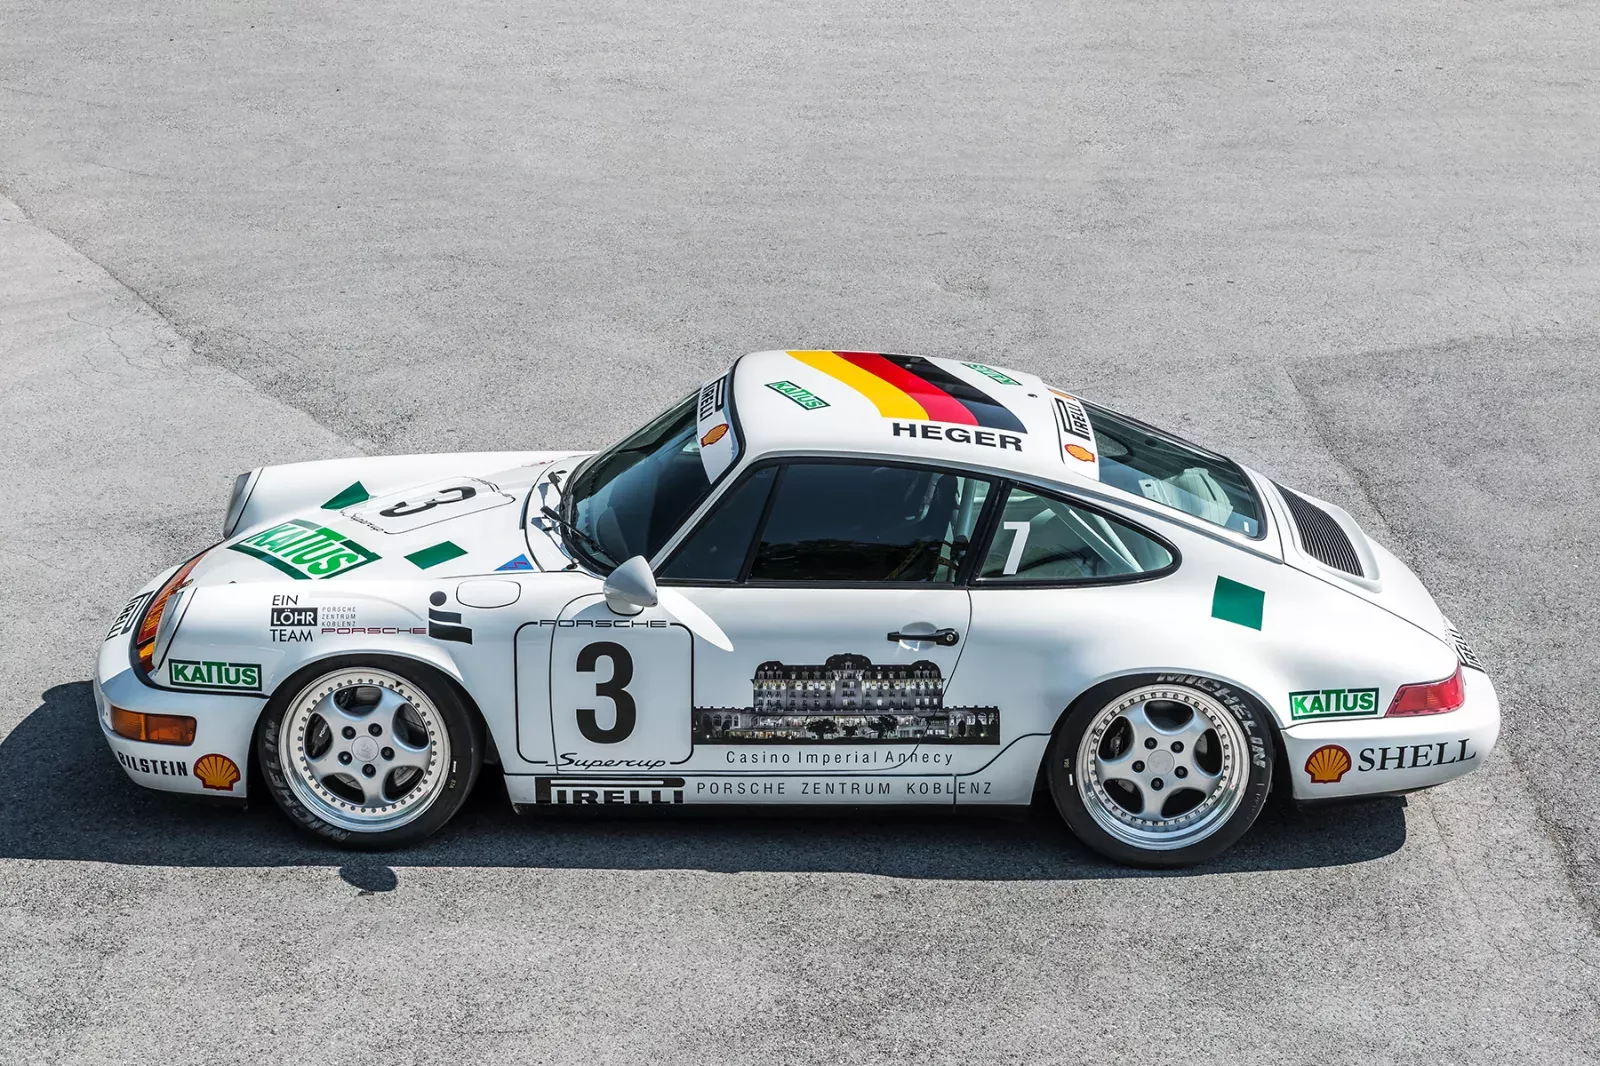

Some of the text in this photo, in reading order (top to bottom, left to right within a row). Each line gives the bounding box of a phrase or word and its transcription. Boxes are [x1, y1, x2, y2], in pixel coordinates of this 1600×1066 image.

[773, 381, 823, 409] KATTUS
[1054, 397, 1091, 441] PIRELLI
[892, 422, 1023, 452] HEGER
[379, 486, 477, 518] 3
[247, 522, 360, 575] KATTUS
[1003, 521, 1031, 575] 7
[272, 594, 299, 606] EIN
[104, 590, 155, 642] PIRELLI
[273, 609, 315, 625] LÖHR
[539, 620, 667, 628] PORSCHE
[270, 629, 313, 642] TEAM
[321, 627, 427, 635] PORSCHE
[173, 661, 257, 686] KATTUS
[576, 641, 637, 744] 3
[1293, 688, 1374, 714] KATTUS
[1156, 672, 1266, 769] MICHELIN
[117, 751, 188, 777] BILSTEIN
[545, 752, 667, 770] Supercup
[726, 751, 953, 766] Casino Imperial Annecy
[1358, 738, 1477, 772] SHELL
[535, 777, 686, 805] PIRELLI
[697, 782, 992, 795] PORSCHE ZENTRUM KOBLENZ
